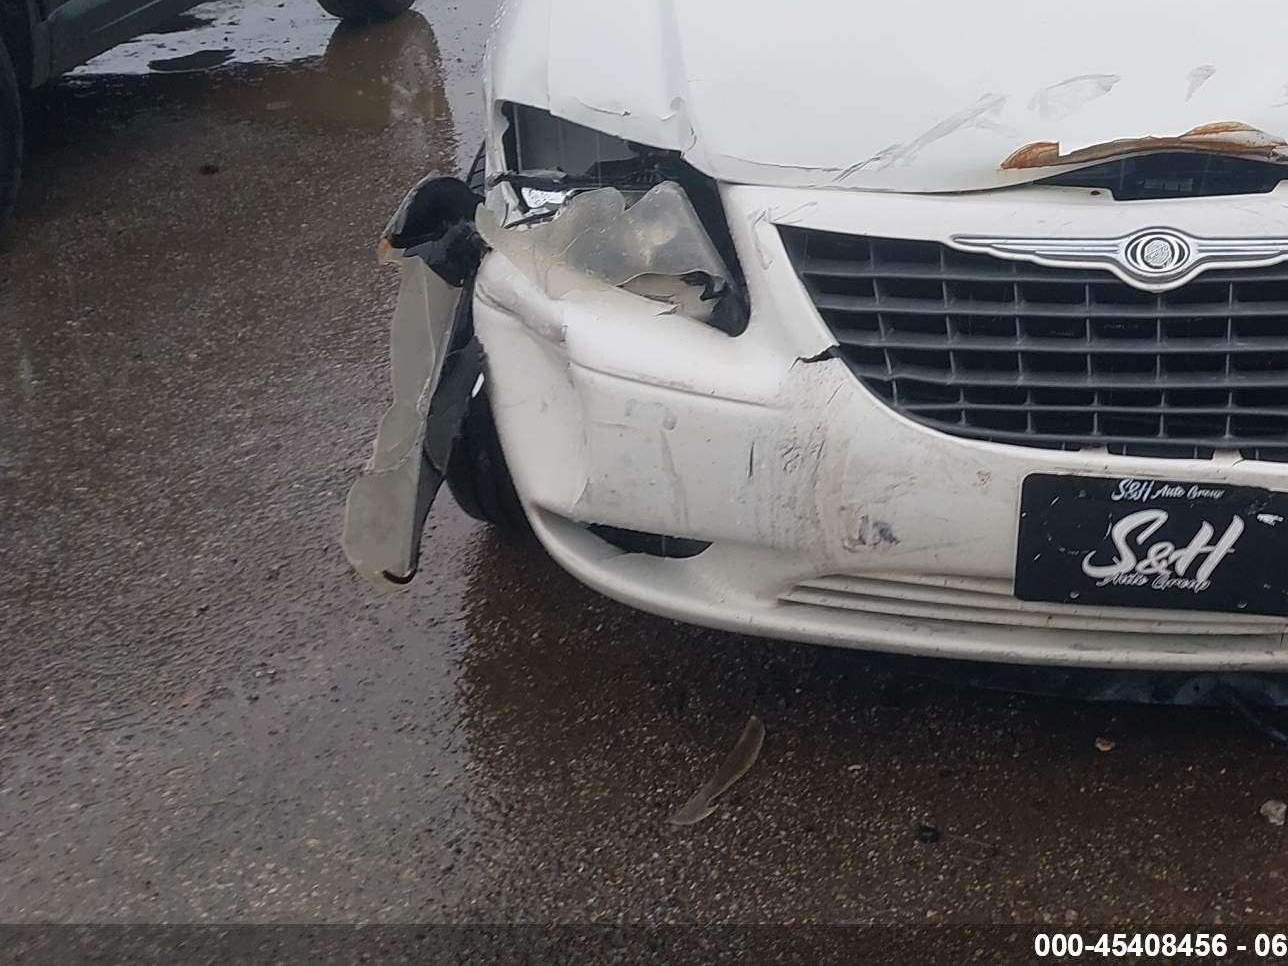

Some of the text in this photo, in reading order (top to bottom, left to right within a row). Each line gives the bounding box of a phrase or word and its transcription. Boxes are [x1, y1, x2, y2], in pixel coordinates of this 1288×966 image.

[1111, 478, 1155, 503] S&H
[1150, 484, 1186, 500] Auto
[1081, 508, 1245, 583] S&H
[1095, 571, 1150, 587] Auto
